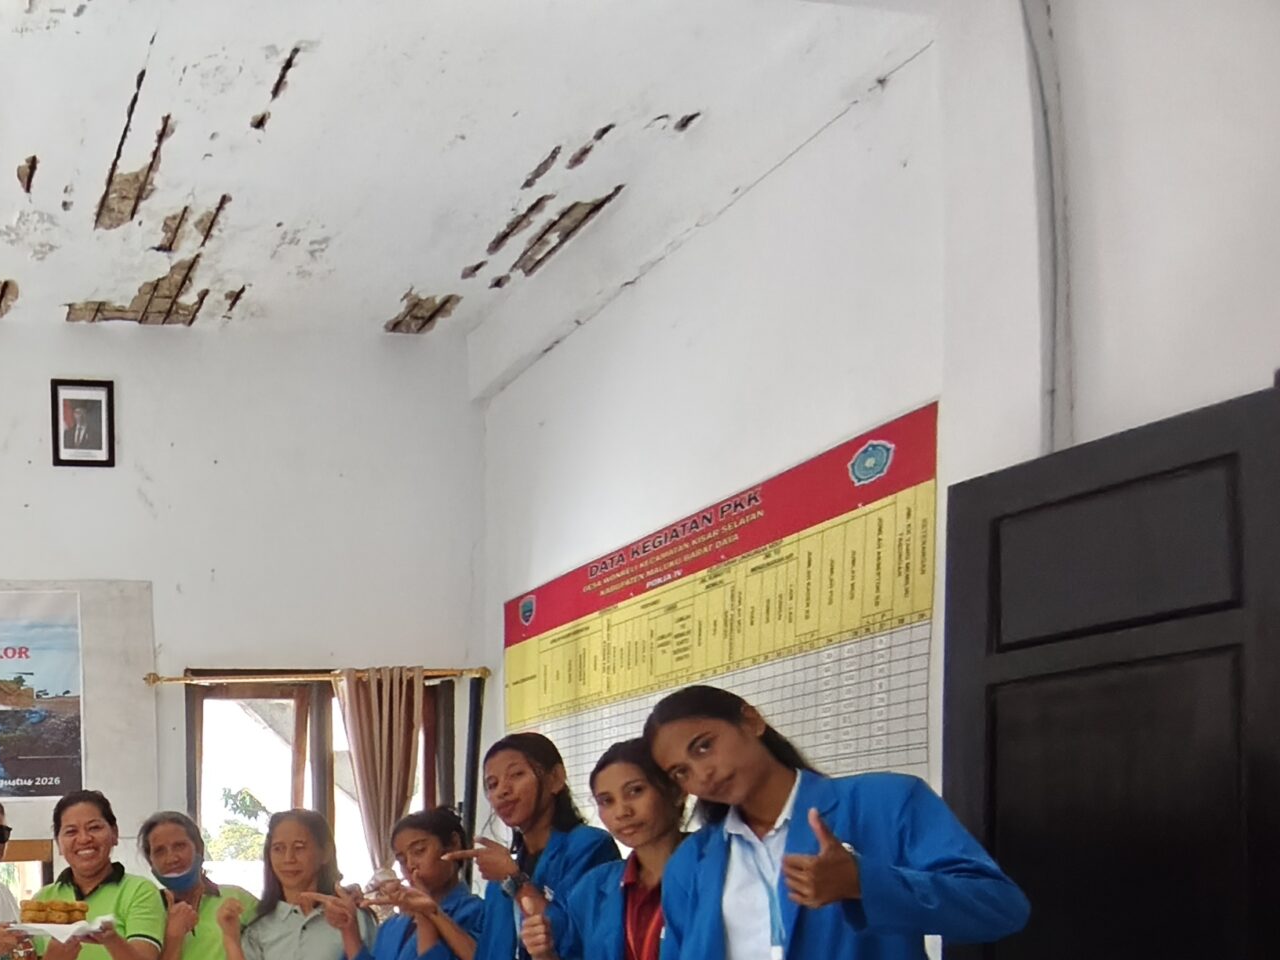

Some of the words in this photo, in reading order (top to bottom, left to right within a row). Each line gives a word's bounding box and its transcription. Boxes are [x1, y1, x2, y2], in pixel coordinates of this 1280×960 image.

[587, 553, 626, 579] DATA
[629, 510, 714, 560] KEGIATAN
[719, 489, 762, 520] PKK
[34, 776, 61, 786] 2026
